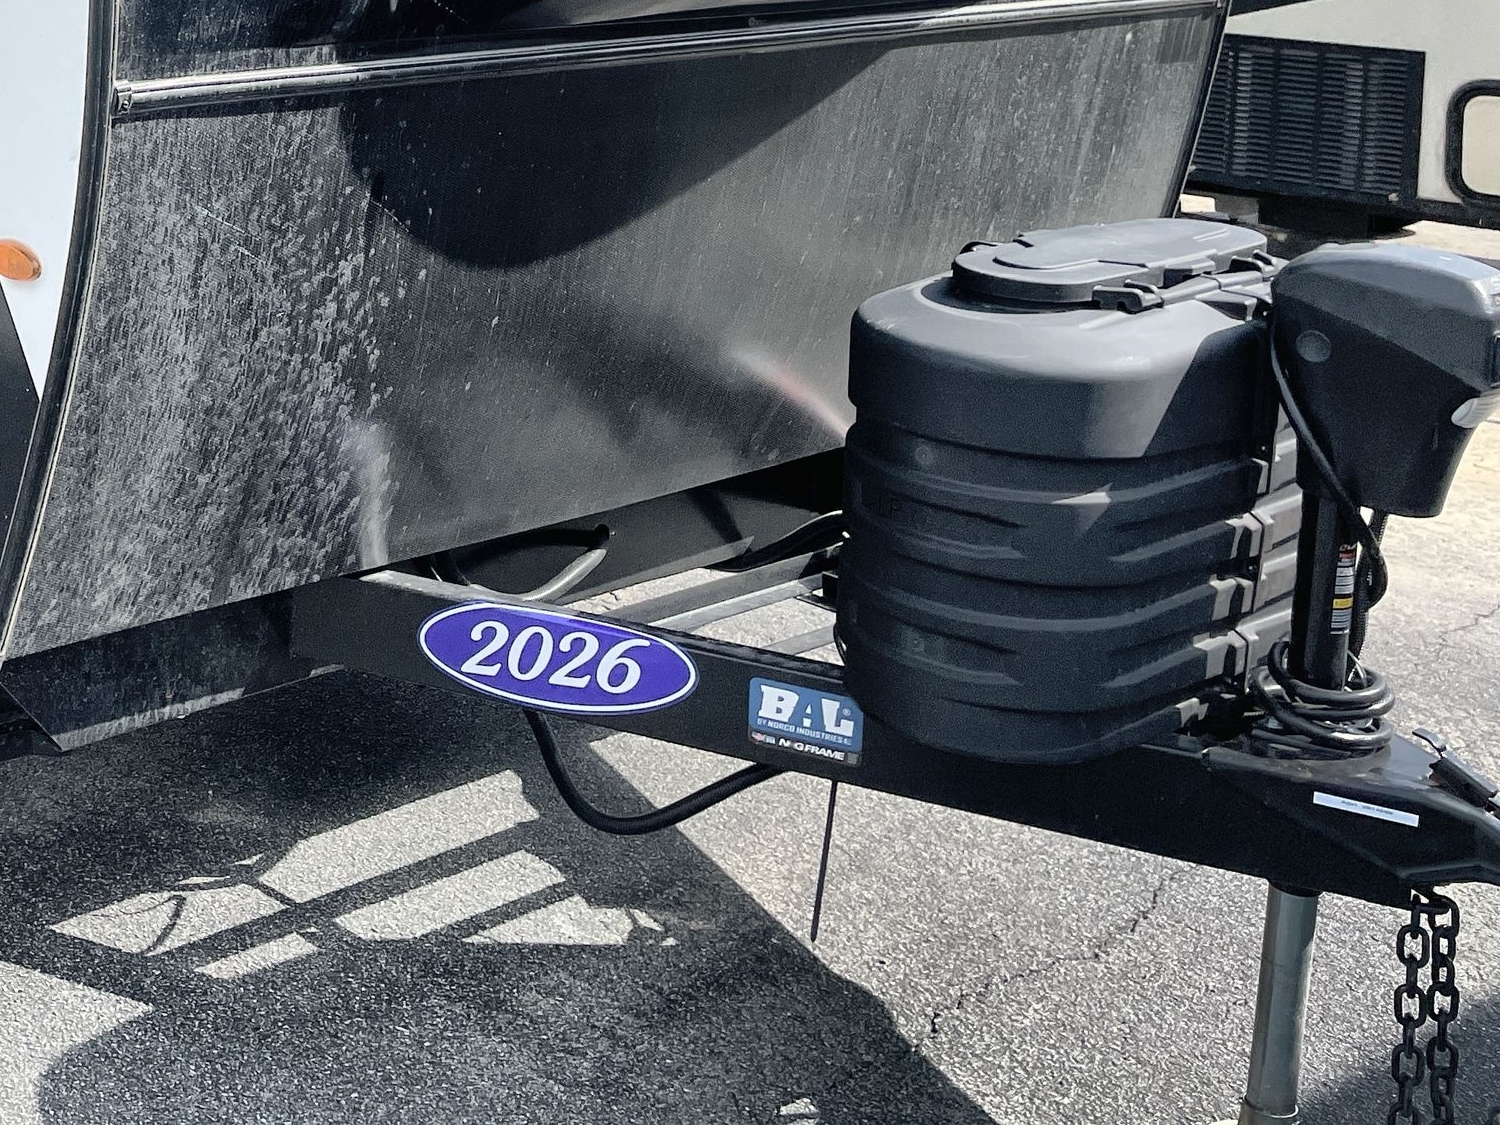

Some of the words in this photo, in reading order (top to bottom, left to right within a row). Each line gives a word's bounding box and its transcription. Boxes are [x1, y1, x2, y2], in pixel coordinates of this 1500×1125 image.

[461, 620, 651, 694] 2026
[758, 684, 854, 737] BAL
[767, 720, 796, 733] NORCO
[796, 726, 844, 743] INDUSTRIES
